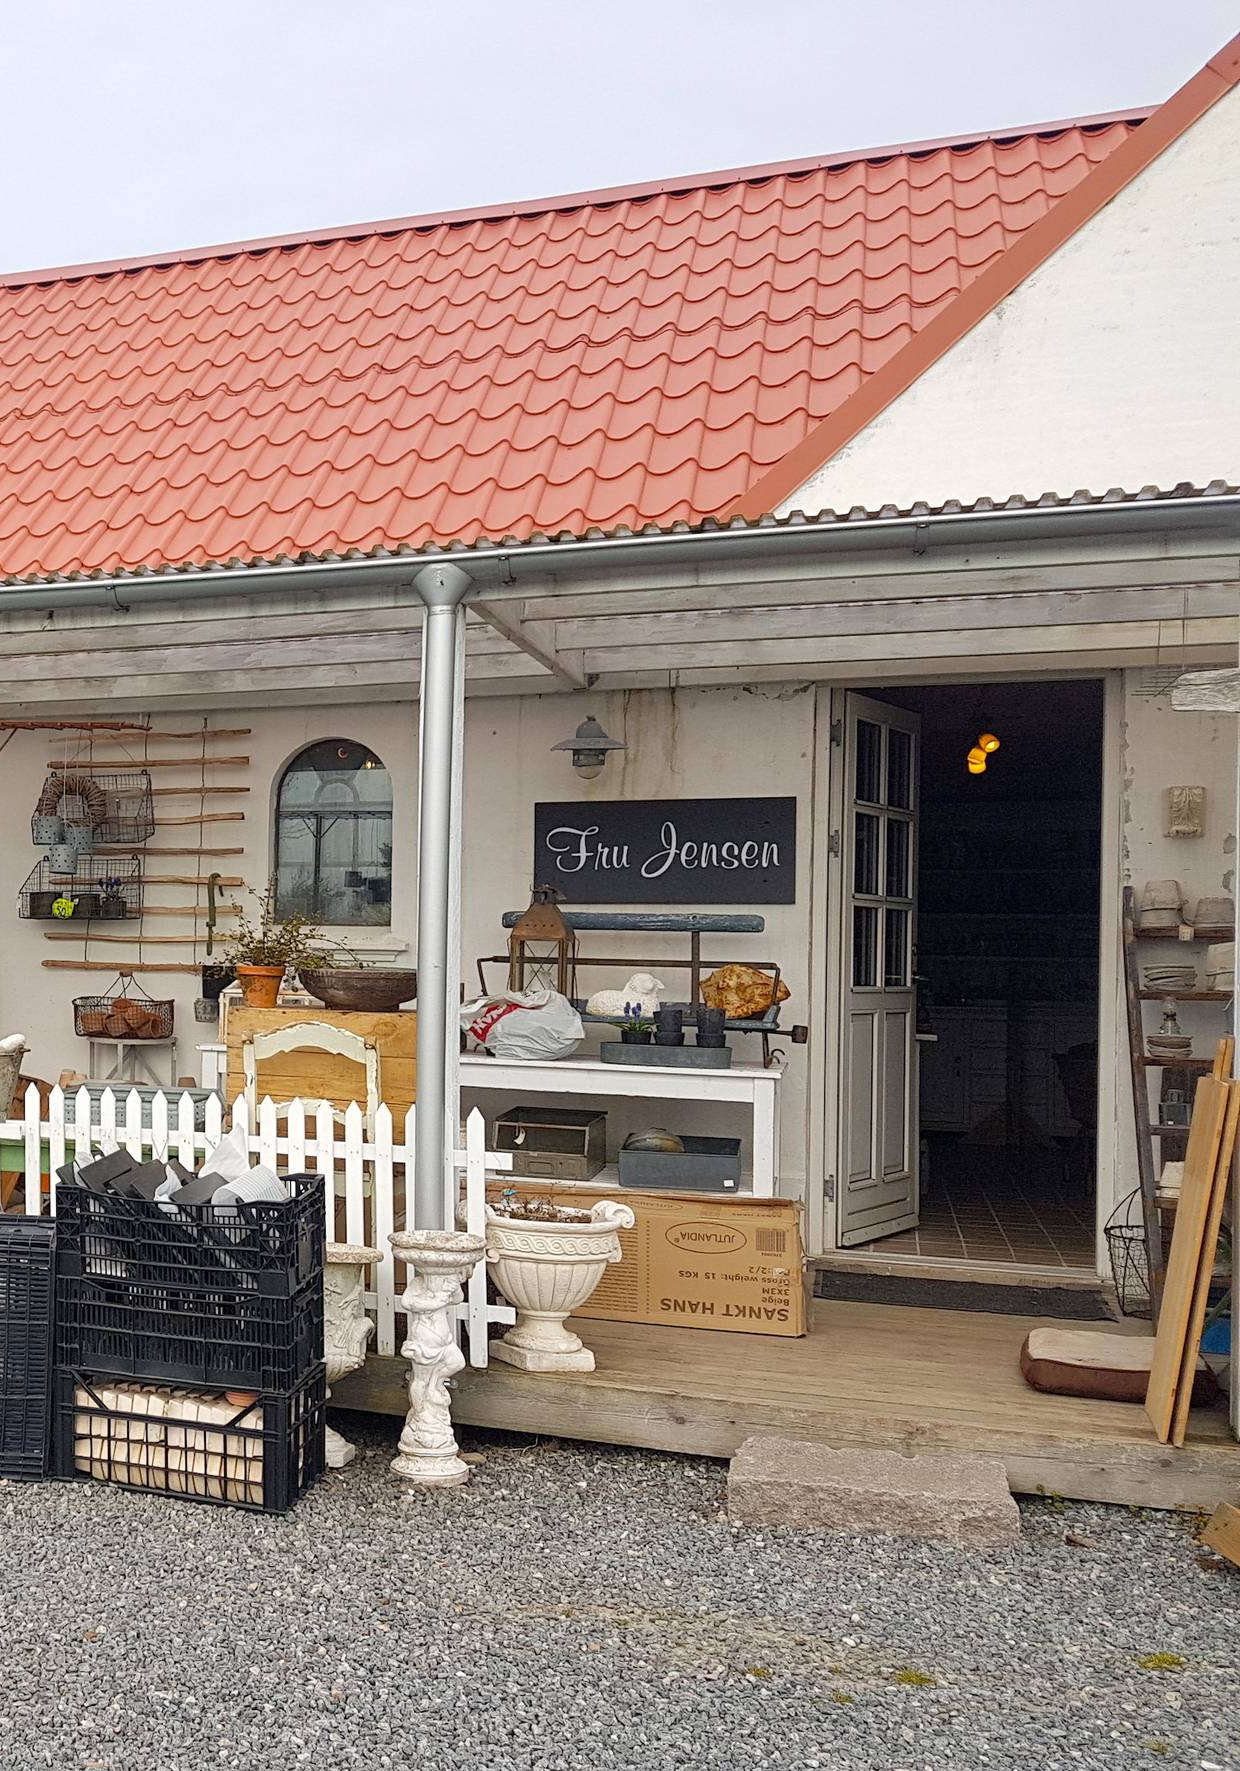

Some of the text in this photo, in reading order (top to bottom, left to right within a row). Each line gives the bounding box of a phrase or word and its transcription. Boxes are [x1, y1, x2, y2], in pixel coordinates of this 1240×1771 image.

[546, 821, 781, 878] Fru Jensen
[679, 1231, 737, 1244] JUTLANDIA
[678, 1270, 791, 1286] Gross weight: 15 KGS
[761, 1287, 791, 1296] 3X3M
[761, 1296, 791, 1307] Beige
[659, 1298, 790, 1322] SANKT HANS
